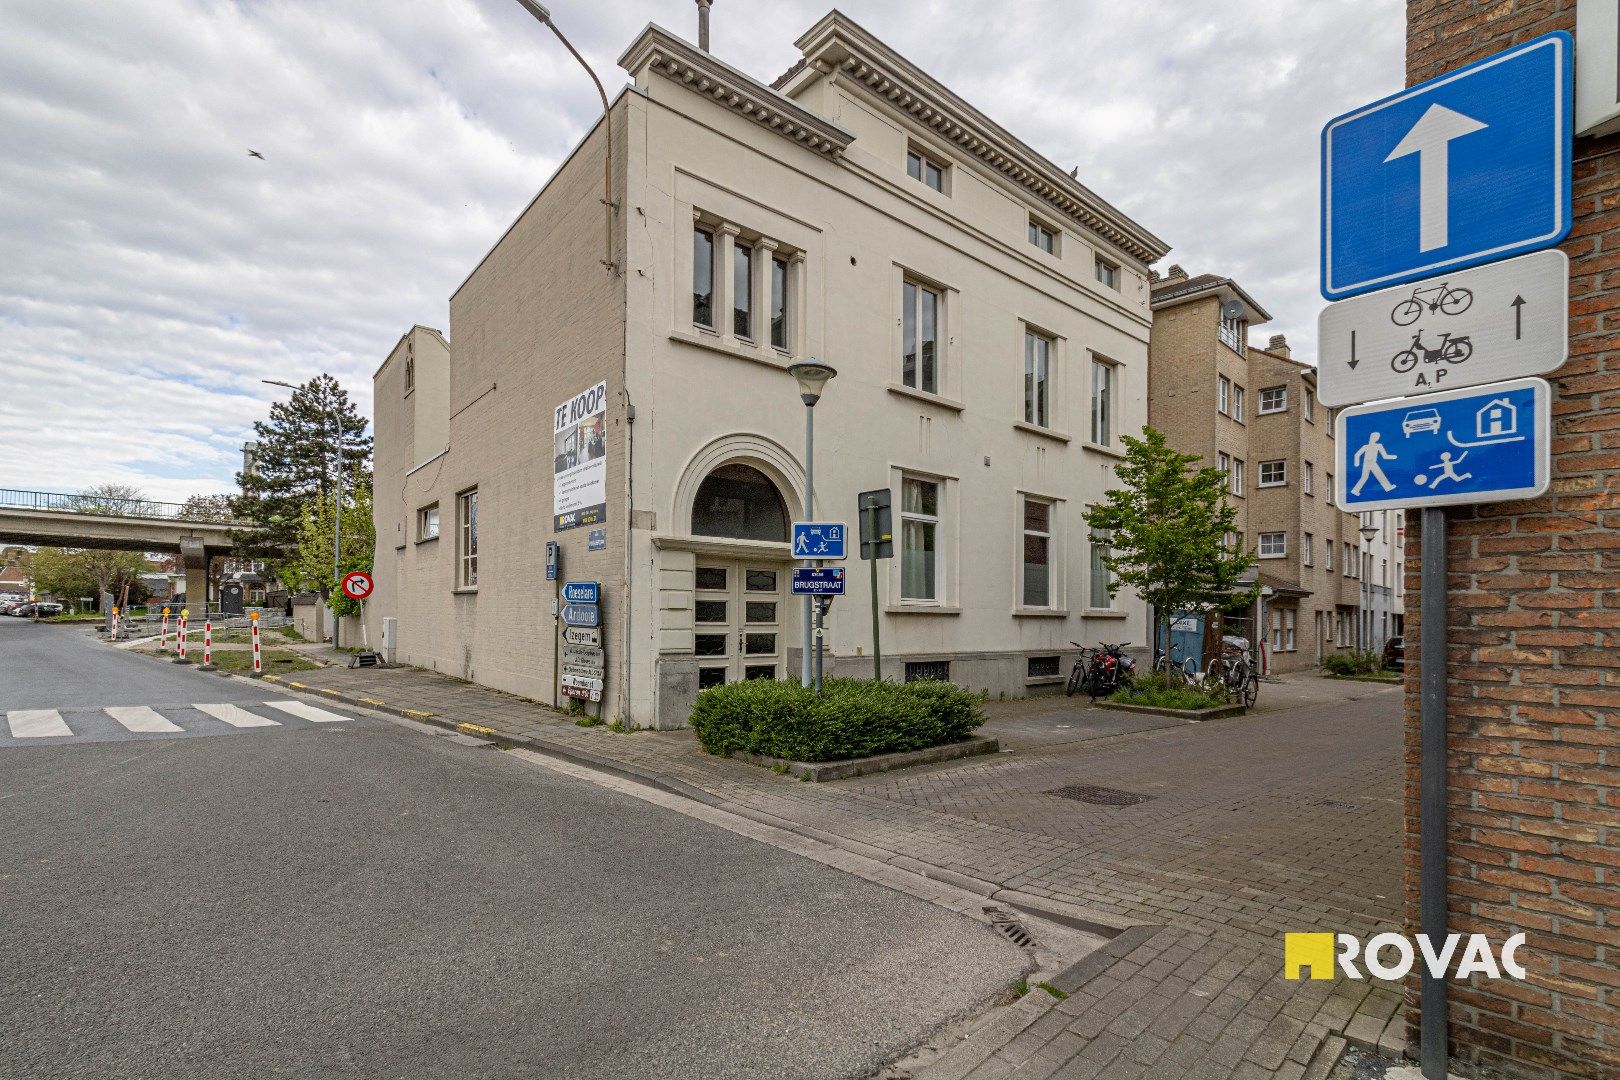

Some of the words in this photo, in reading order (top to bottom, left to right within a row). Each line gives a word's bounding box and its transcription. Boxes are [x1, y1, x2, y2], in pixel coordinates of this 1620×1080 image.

[1436, 368, 1447, 383] P
[556, 405, 567, 430] TE
[570, 384, 604, 423] KOOP
[569, 585, 593, 599] Roeselare
[794, 581, 842, 589] BRUGSTRAAT
[568, 607, 594, 622] Ardooie
[569, 629, 590, 643] Izegem
